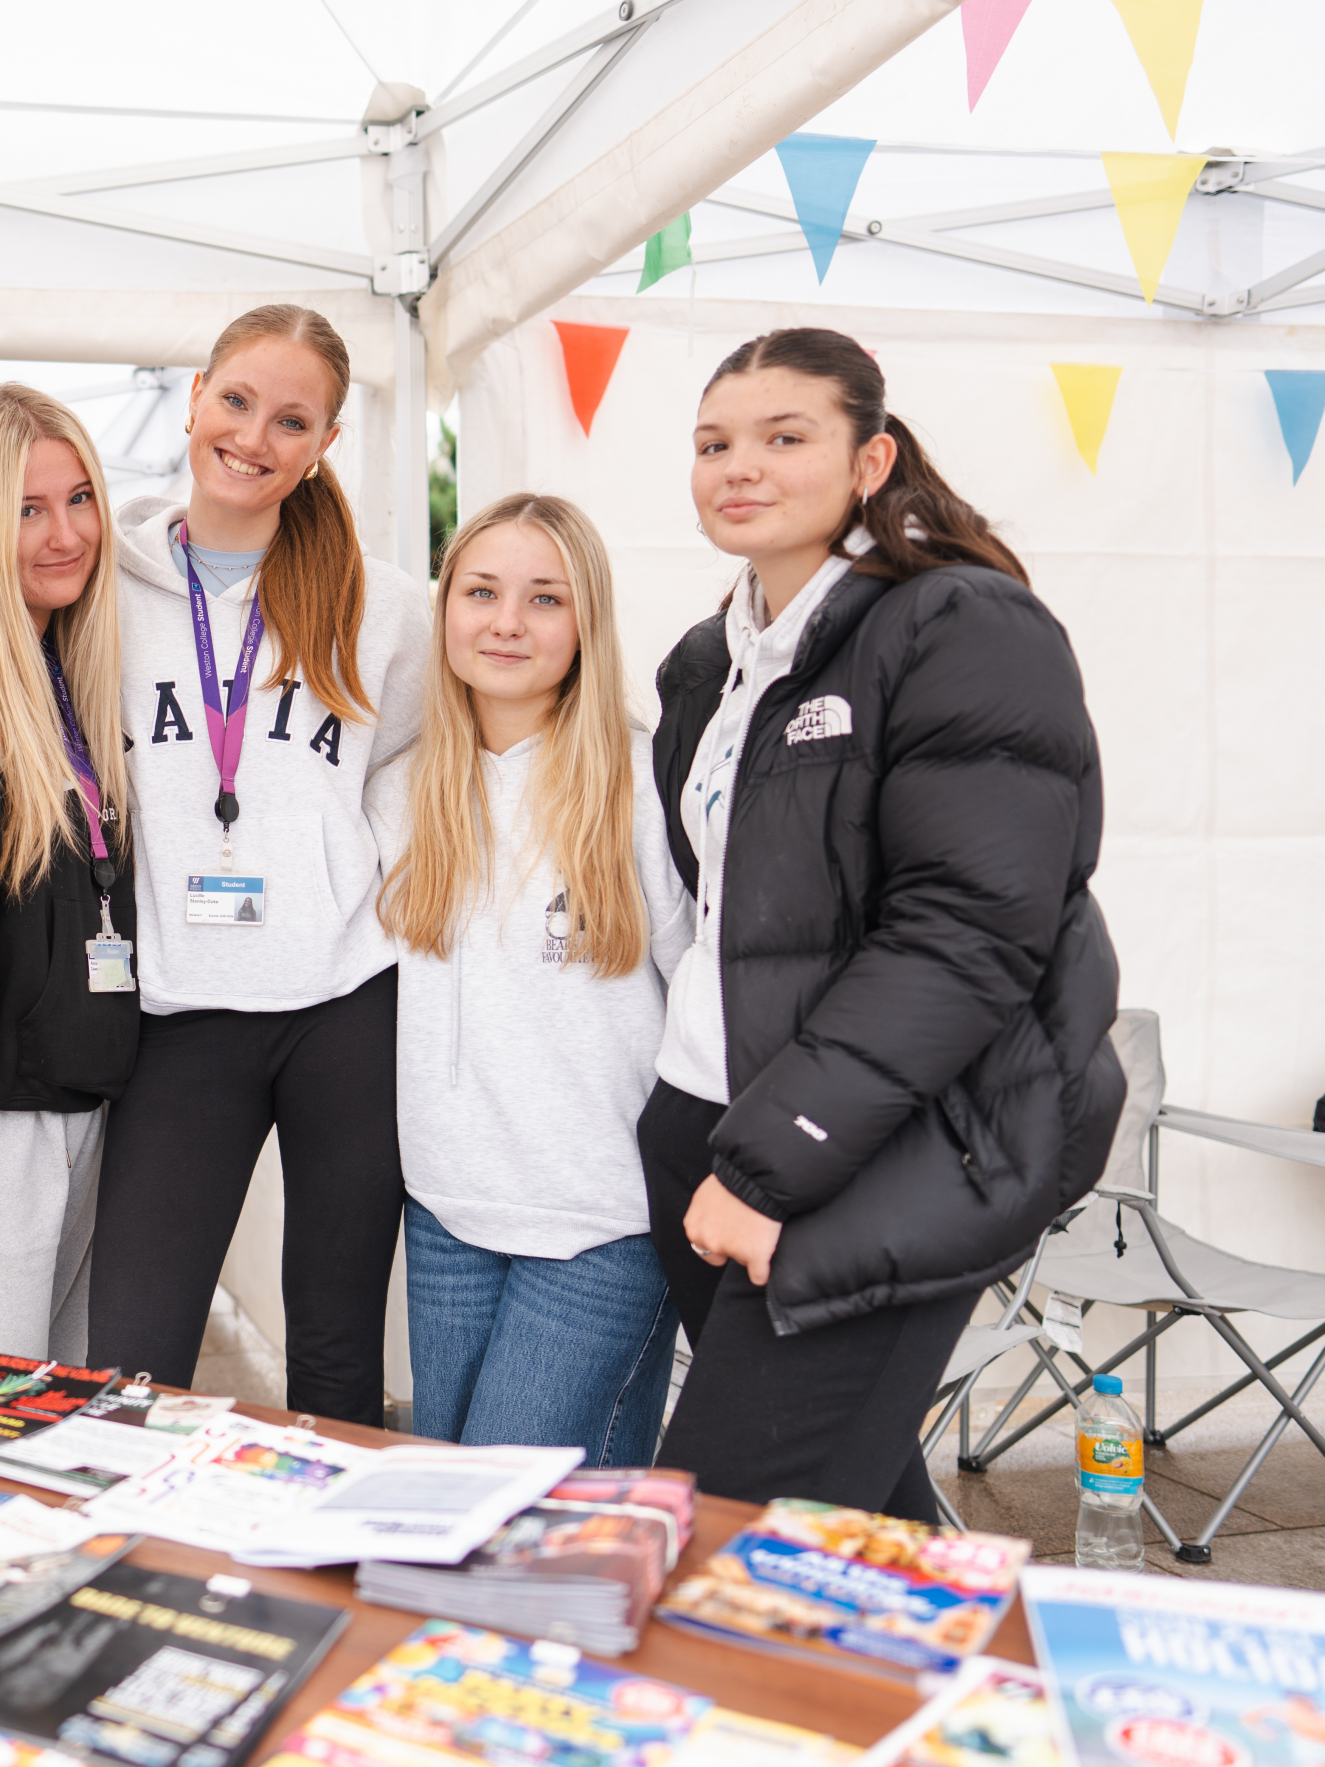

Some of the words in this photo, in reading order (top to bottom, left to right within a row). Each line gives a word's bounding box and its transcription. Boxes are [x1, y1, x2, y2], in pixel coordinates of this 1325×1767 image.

[195, 593, 204, 621] Student
[198, 623, 208, 649] College
[203, 651, 212, 678] Weston
[240, 646, 254, 674] Student
[798, 696, 825, 717] THE
[786, 725, 824, 746] FACE
[1095, 1441, 1128, 1455] Volvic
